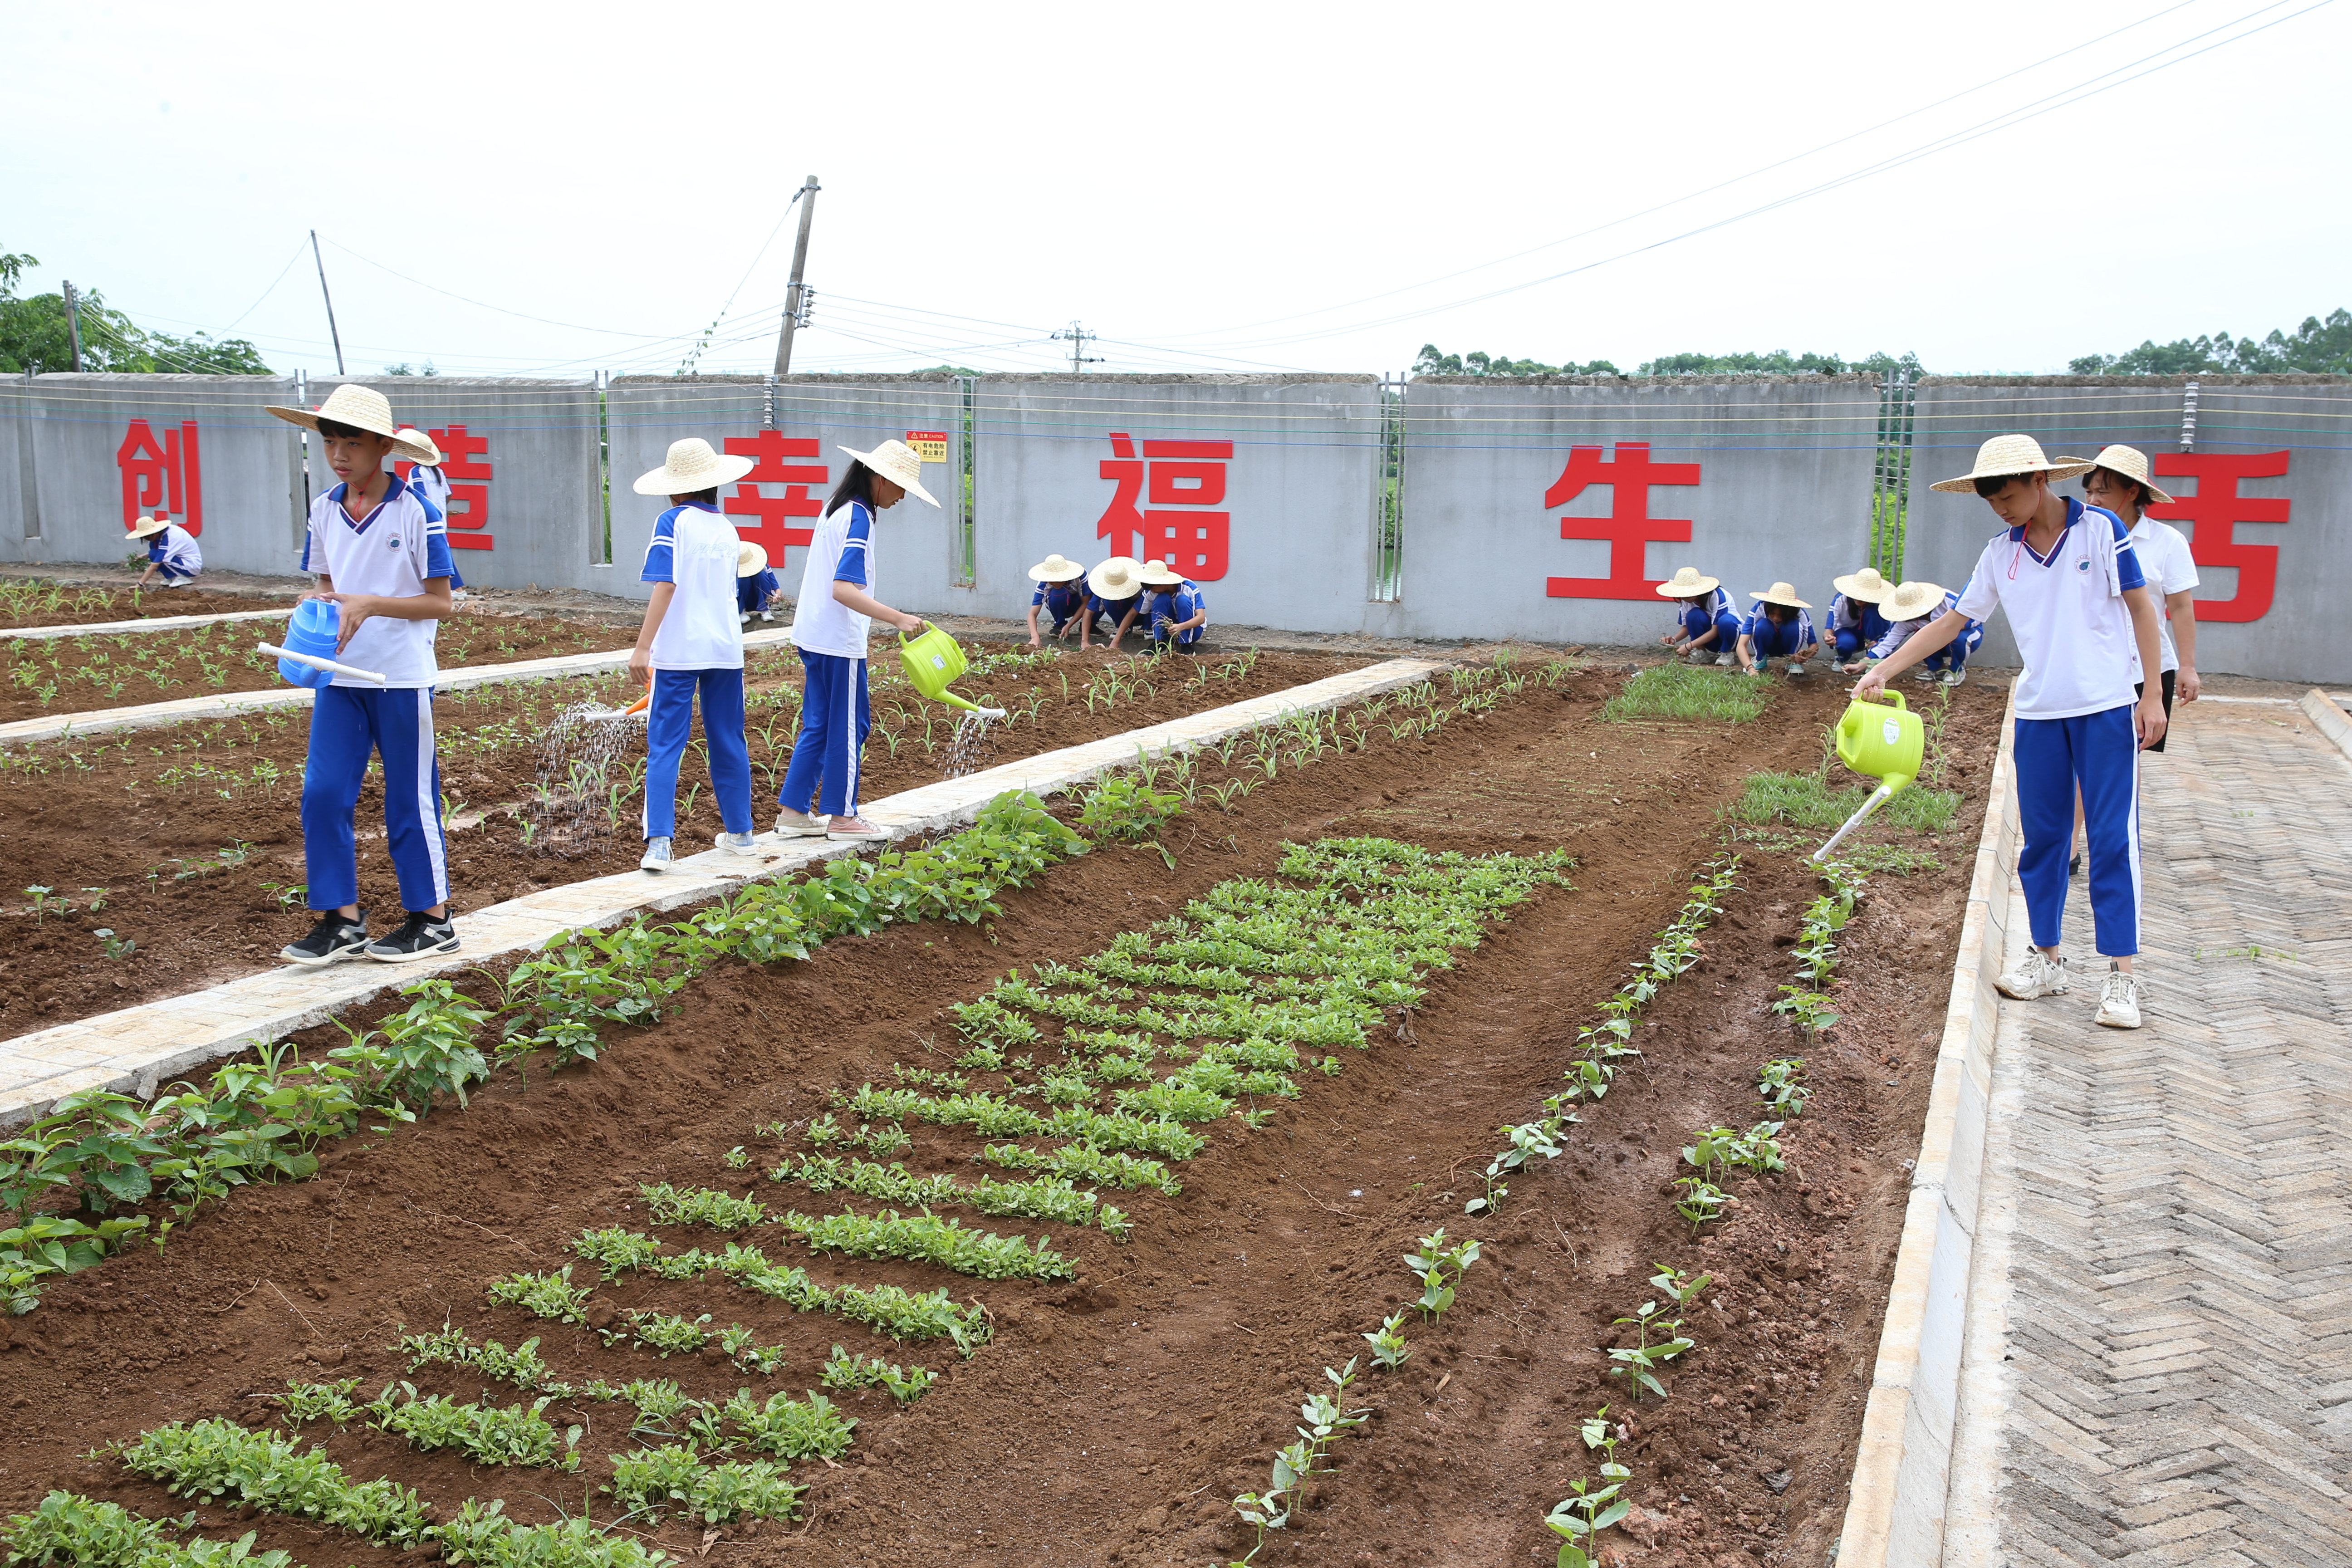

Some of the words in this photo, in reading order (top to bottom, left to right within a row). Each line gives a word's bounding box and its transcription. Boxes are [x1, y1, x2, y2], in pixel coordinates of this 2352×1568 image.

[117, 419, 202, 537] 创
[724, 430, 828, 568] 幸
[1097, 432, 1233, 581] 福
[1545, 441, 1700, 601] 生
